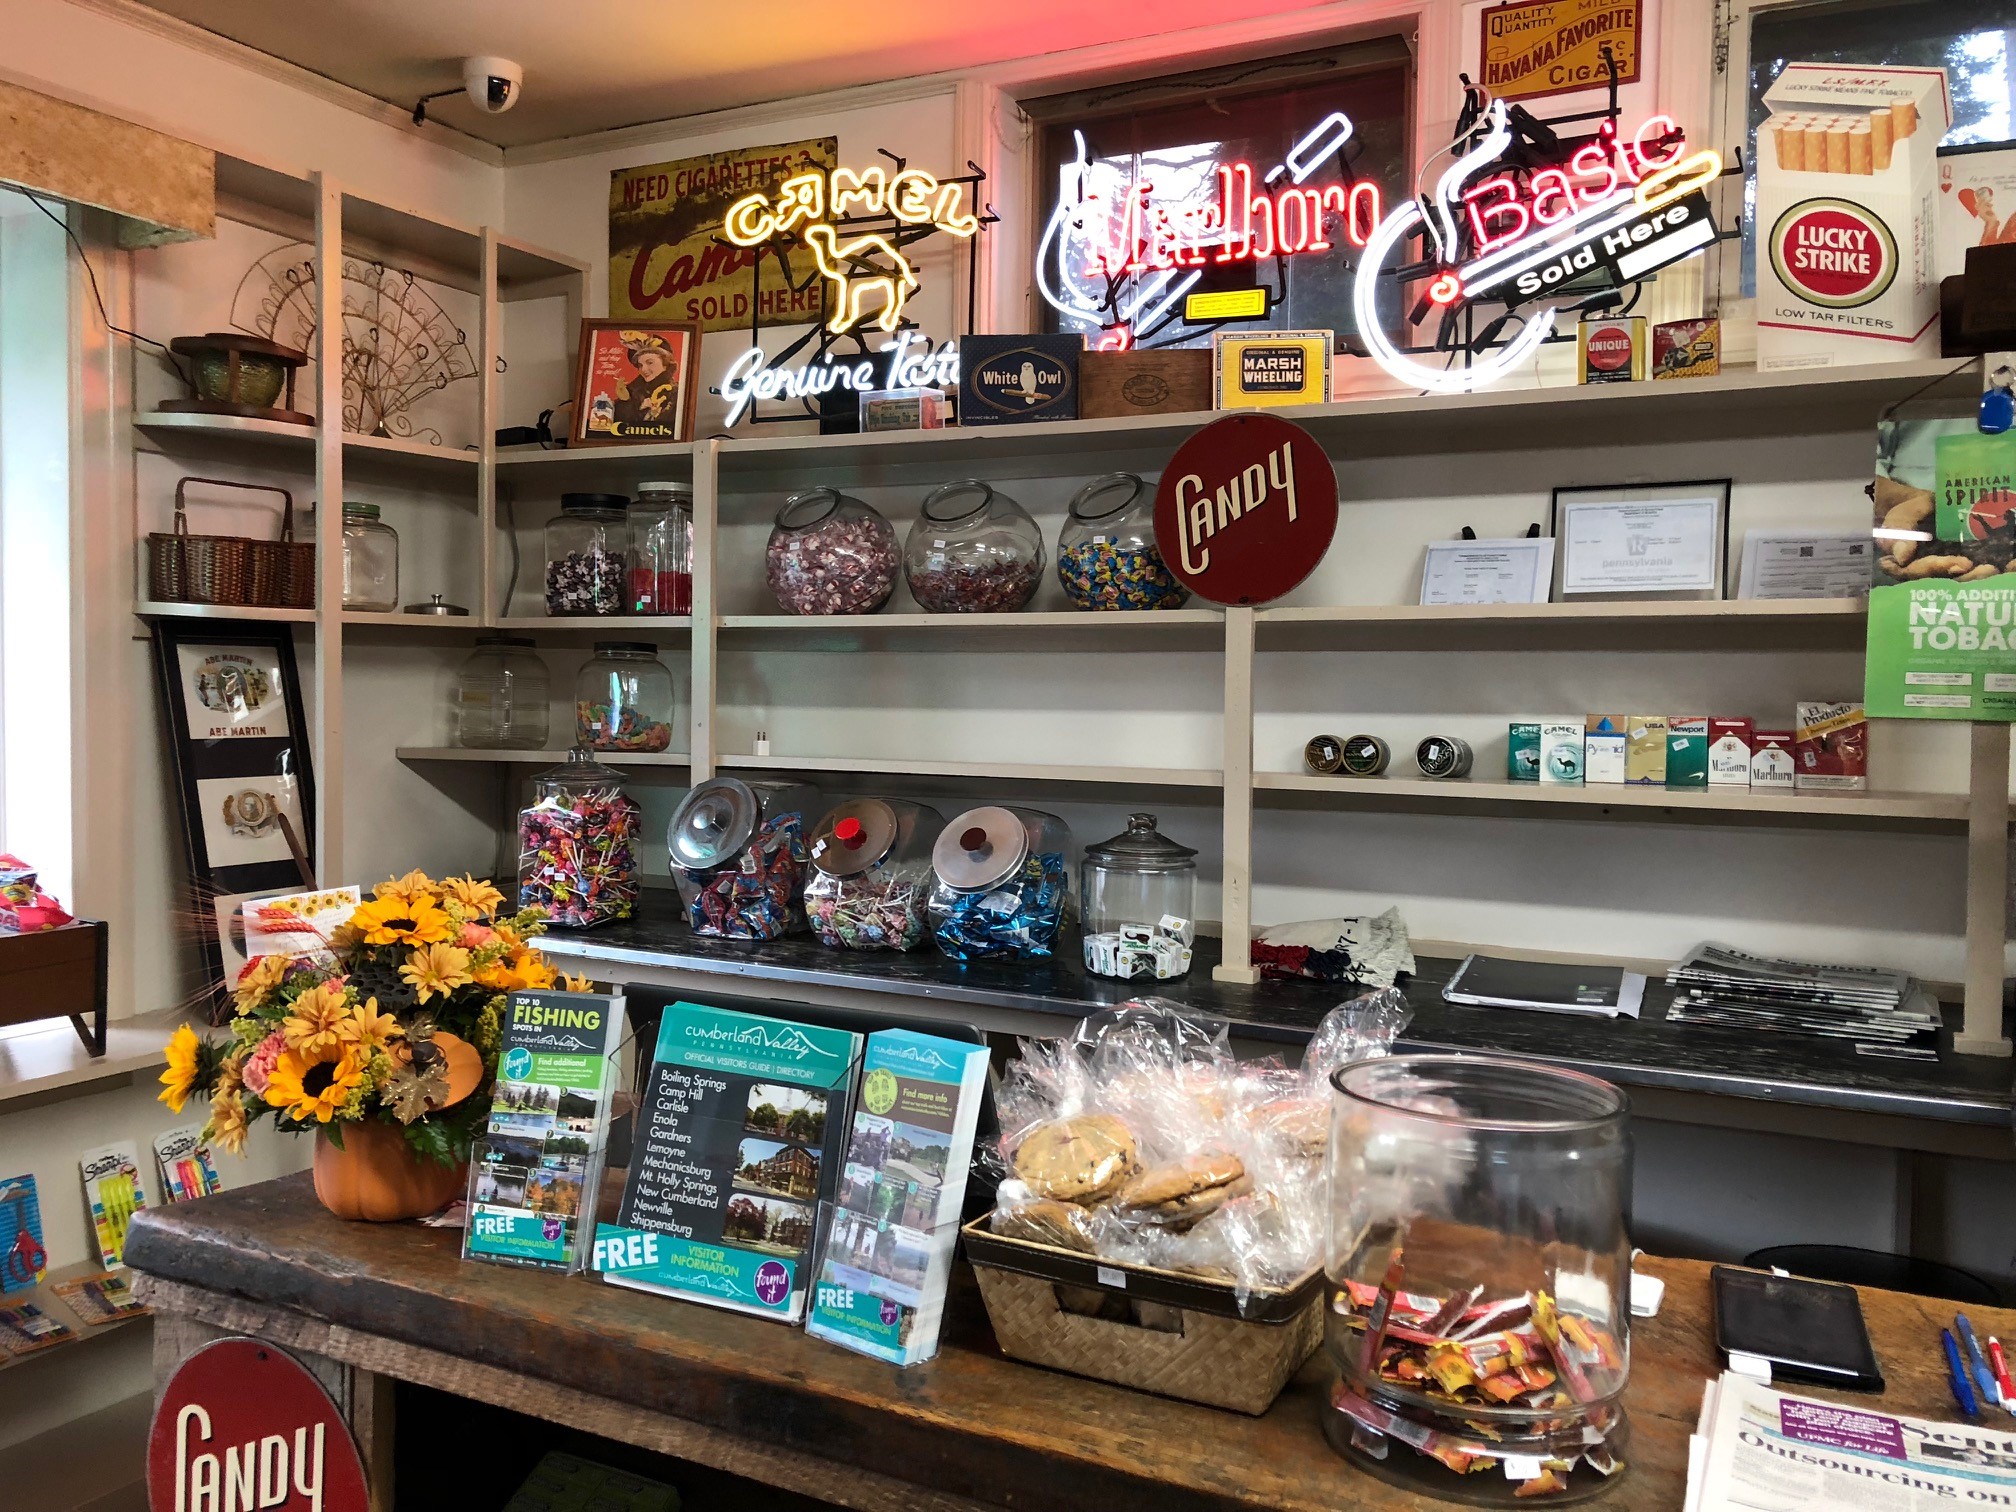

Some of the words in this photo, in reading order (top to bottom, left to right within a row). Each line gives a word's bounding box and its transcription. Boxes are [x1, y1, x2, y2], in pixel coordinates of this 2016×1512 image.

[1489, 41, 1555, 84] HAVANA
[1557, 9, 1633, 56] FAVORITE
[1549, 60, 1628, 85] CIGAR
[623, 173, 669, 205] NEED
[1463, 114, 1685, 259] Basic
[725, 167, 978, 246] CAMEL
[1085, 163, 1379, 277] Marlboro
[1798, 225, 1868, 250] LUCKY
[1517, 249, 1596, 295] Sold
[1602, 205, 1690, 256] Here
[1795, 248, 1870, 274] STRIKE
[686, 293, 748, 321] SOLD
[759, 286, 820, 315] HERE
[1775, 308, 1805, 319] LOW
[1809, 311, 1834, 322] TAR
[1838, 314, 1894, 329] FILTERS
[1589, 339, 1630, 352] UNIQUE
[1244, 358, 1302, 370] MARSH
[721, 347, 874, 428] Genuine
[880, 331, 960, 392] Tast
[983, 371, 1018, 385] White
[1038, 371, 1061, 384] Owl
[1244, 371, 1302, 383] WHEELING
[610, 422, 672, 437] Camels
[1945, 475, 2011, 488] AMERICAN
[1945, 486, 2011, 506] SPIRIT
[1176, 441, 1298, 575] CANDY
[1602, 557, 1673, 569] pennsylvania
[1910, 589, 1953, 601] 100%
[1909, 602, 2016, 626] NATU
[205, 655, 220, 666] ABE
[222, 654, 253, 667] MARTIN
[1803, 705, 1851, 726] Producto
[1808, 707, 1820, 716] El
[209, 727, 228, 737] ABE
[231, 726, 267, 737] MARTIN
[1544, 726, 1578, 735] CAMEL
[1670, 725, 1705, 733] Newport
[1753, 764, 1793, 781] Marlboro
[516, 997, 530, 1005] TOP
[513, 1005, 600, 1030] FISHING
[512, 1024, 533, 1032] SPOTS
[693, 1040, 793, 1060] PENNSYLVANIA
[505, 1052, 530, 1070] found
[538, 1057, 552, 1066] Find
[553, 1057, 587, 1067] additional
[684, 1052, 715, 1064] OFFICIAL
[716, 1057, 748, 1069] VISITORS
[749, 1062, 771, 1073] GUIDE
[776, 1066, 815, 1080] DIRECTORY
[661, 1069, 691, 1088] Boiling
[693, 1074, 727, 1093] Springs
[658, 1084, 687, 1099] Camp
[688, 1088, 704, 1101] Hill
[902, 1087, 917, 1098] Find
[917, 1091, 934, 1101] more
[935, 1092, 948, 1103] info
[656, 1097, 689, 1113] Carlisle
[652, 1112, 679, 1127] Enola
[649, 1126, 692, 1144] Gardners
[646, 1140, 686, 1158] Lemoyne
[643, 1155, 712, 1180] Mechanicsburg
[639, 1169, 654, 1182] Mt.
[656, 1172, 681, 1190] Holly
[683, 1177, 718, 1196] Springs
[636, 1183, 659, 1197] New
[661, 1188, 719, 1209] Cumberland
[633, 1198, 673, 1216] Newville
[476, 1217, 515, 1235] FREE
[630, 1212, 693, 1239] Shippensburg
[480, 1233, 506, 1243] VISITOR
[508, 1237, 556, 1250] INFORMATION
[592, 1233, 659, 1271] FREE
[688, 1245, 725, 1262] VISITOR
[670, 1253, 740, 1278] INFORMATION
[756, 1267, 788, 1288] found
[767, 1286, 777, 1303] it
[818, 1288, 854, 1310] FREE
[1796, 1432, 1842, 1445] UPMC
[1865, 1444, 1890, 1454] Life
[1739, 1431, 1957, 1499] Outsourcing
[1967, 1489, 2011, 1505] on
